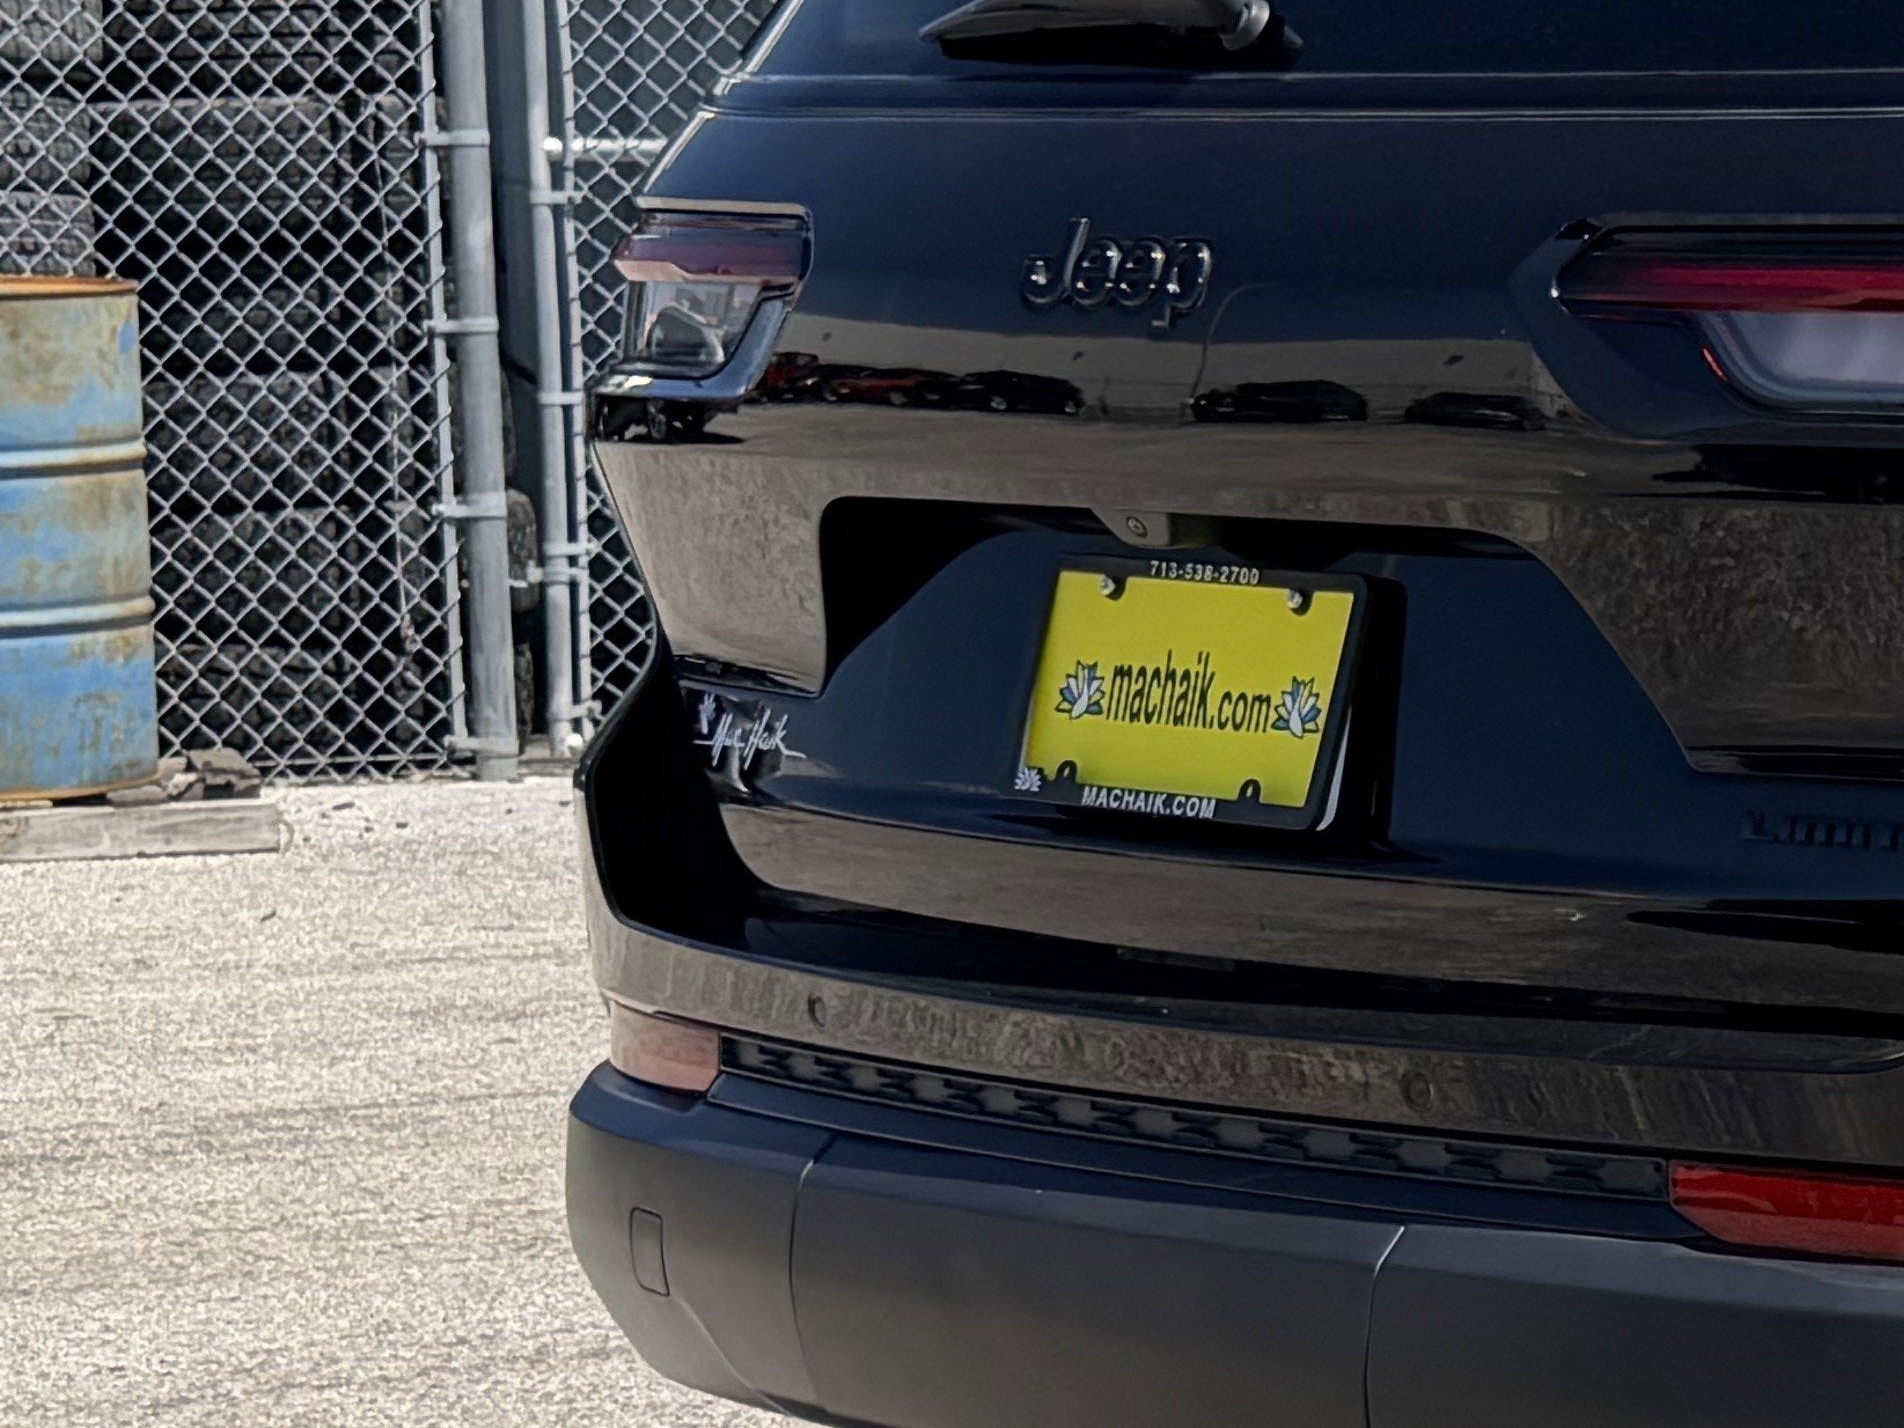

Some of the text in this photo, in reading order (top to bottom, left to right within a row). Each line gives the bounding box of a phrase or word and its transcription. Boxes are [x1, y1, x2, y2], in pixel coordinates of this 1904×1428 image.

[1021, 215, 1216, 331] Jeep
[1149, 559, 1261, 586] 713-538-2700
[1105, 648, 1273, 734] machaik.com
[1081, 785, 1217, 820] MACHAIK.COM
